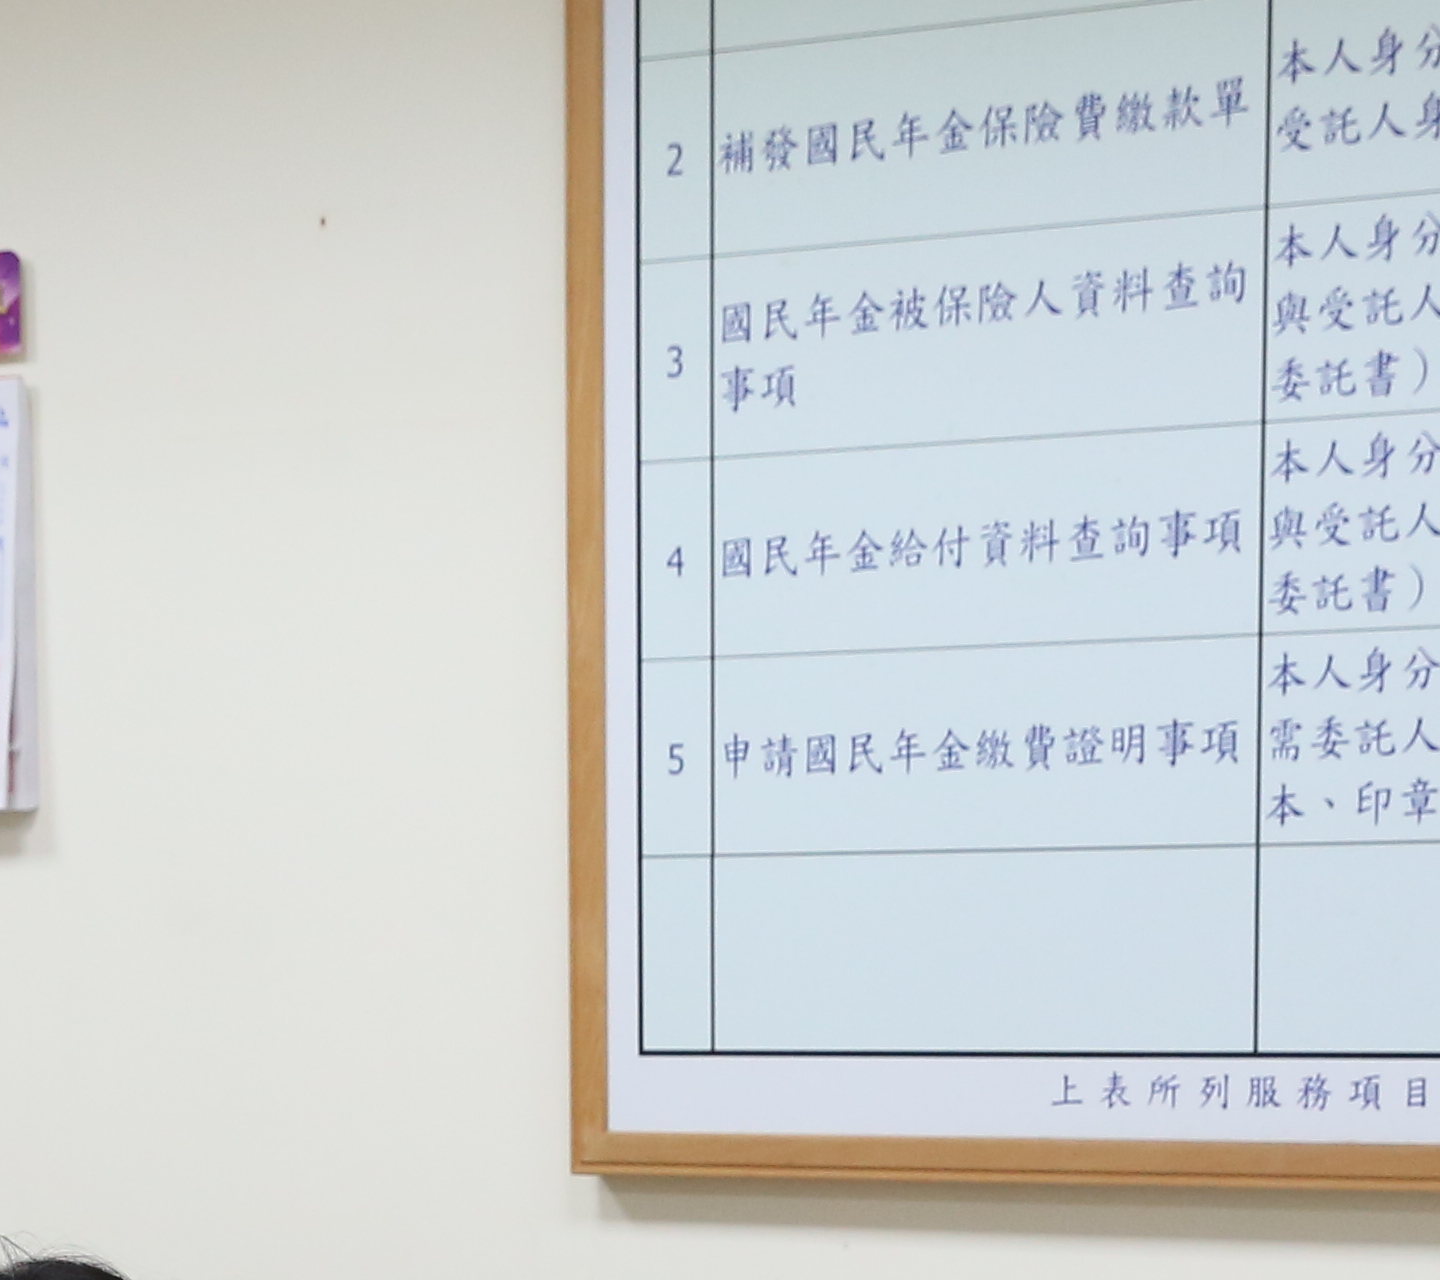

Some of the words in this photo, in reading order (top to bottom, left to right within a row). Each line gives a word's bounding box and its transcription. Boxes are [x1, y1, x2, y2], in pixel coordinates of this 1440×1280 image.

[720, 76, 1251, 177] 補發國民年金保險費繳款單
[666, 144, 685, 178] 2
[721, 260, 1247, 345] 國民年金被保險人資料查詢
[666, 346, 685, 378] 3
[721, 364, 798, 412] 事項
[666, 545, 685, 579] 4
[721, 508, 1243, 580] 國民年金給付資料查詢事項
[668, 744, 685, 776] 5
[723, 717, 1241, 781] 申請國民年金繳費證明事項
